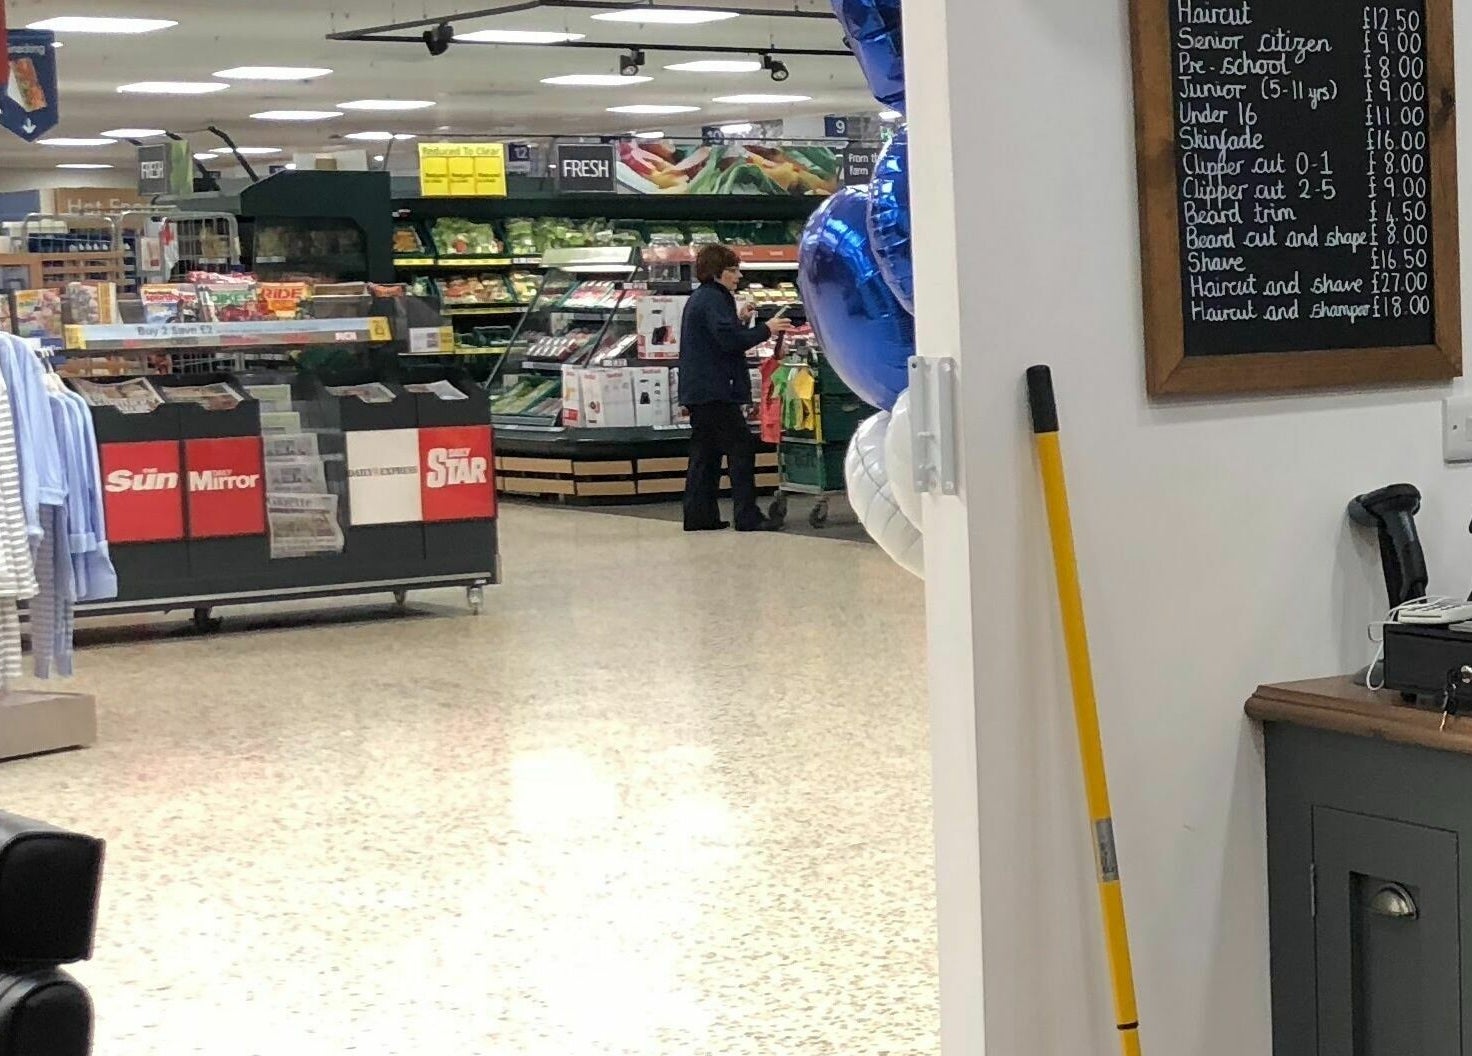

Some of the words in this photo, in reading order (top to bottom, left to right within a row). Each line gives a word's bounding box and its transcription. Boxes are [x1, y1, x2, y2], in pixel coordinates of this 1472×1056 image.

[1178, 0, 1252, 25] Haircut
[1178, 27, 1244, 49] Senior
[1257, 27, 1333, 64] citizen
[1178, 76, 1246, 99] Junior
[1179, 102, 1229, 125] Under
[1238, 102, 1258, 126] 16
[835, 120, 845, 134] 9
[563, 159, 609, 177] FRESH
[1182, 152, 1244, 186] Clipper
[1251, 153, 1287, 173] cut
[1183, 177, 1248, 209] Clipper
[1254, 180, 1287, 199] cut
[1184, 201, 1243, 225] Beard
[1254, 203, 1297, 222] trim
[1186, 226, 1235, 249] Beard
[1243, 225, 1278, 247] cut
[1285, 225, 1318, 246] and
[1324, 226, 1368, 253] shape
[1188, 251, 1246, 272] Shave
[262, 288, 304, 300] RIDE
[1190, 274, 1257, 297] Haircut
[1263, 271, 1301, 295] and
[1310, 274, 1363, 294] shave
[1371, 271, 1428, 293] £27.00
[1191, 299, 1257, 321] Haircut
[1263, 299, 1299, 320] and
[105, 469, 178, 492] Sun
[188, 469, 259, 492] Mirror
